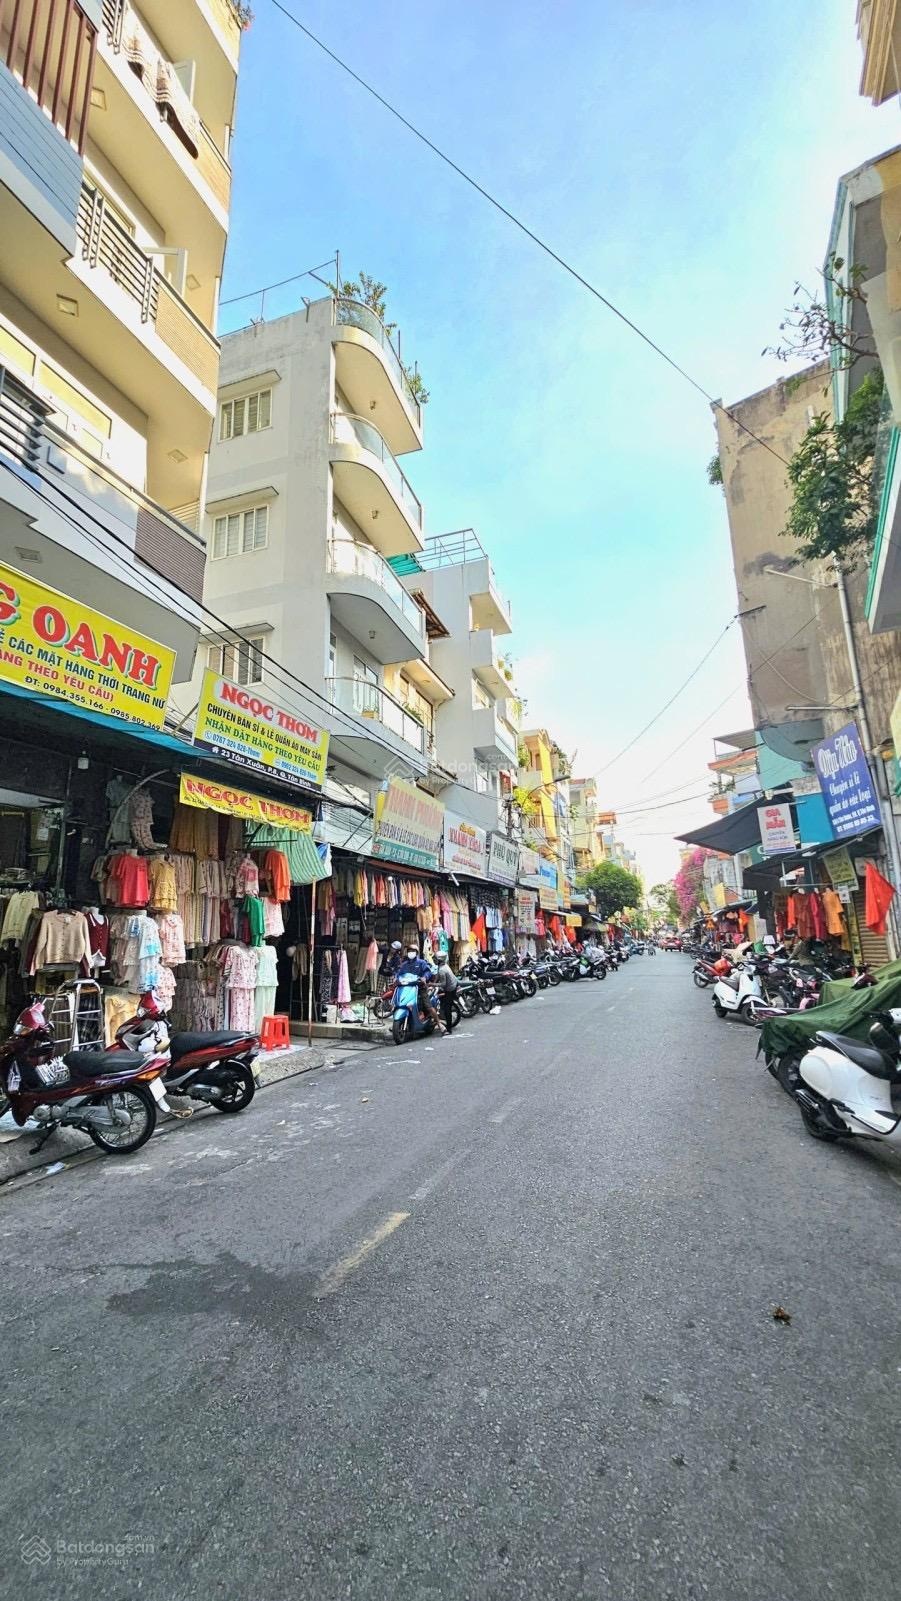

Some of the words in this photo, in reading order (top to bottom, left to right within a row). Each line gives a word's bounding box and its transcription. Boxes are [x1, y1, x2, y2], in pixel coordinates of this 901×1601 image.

[32, 604, 161, 690] OANH
[9, 636, 34, 655] CÁC
[37, 648, 62, 668] MẶT
[65, 657, 95, 680] HÀNG
[122, 683, 150, 704] TRANG
[28, 660, 58, 680] THEO
[63, 673, 85, 690] YÊU
[25, 675, 40, 687] ĐT:
[43, 681, 104, 710] 0984.355.166
[207, 702, 236, 723] CHUYÊN
[237, 714, 251, 729] BÁN
[260, 727, 266, 737] &
[220, 682, 274, 721] NGỌC
[277, 711, 318, 743] THƠM
[205, 716, 232, 737] NHẬN
[233, 727, 250, 743] ĐẶT
[251, 736, 274, 752] HÀNG
[275, 747, 292, 760] THEO
[294, 752, 307, 767] YÊU
[221, 748, 230, 759] 23
[231, 752, 245, 765] Tân
[185, 779, 253, 810] NGỌC
